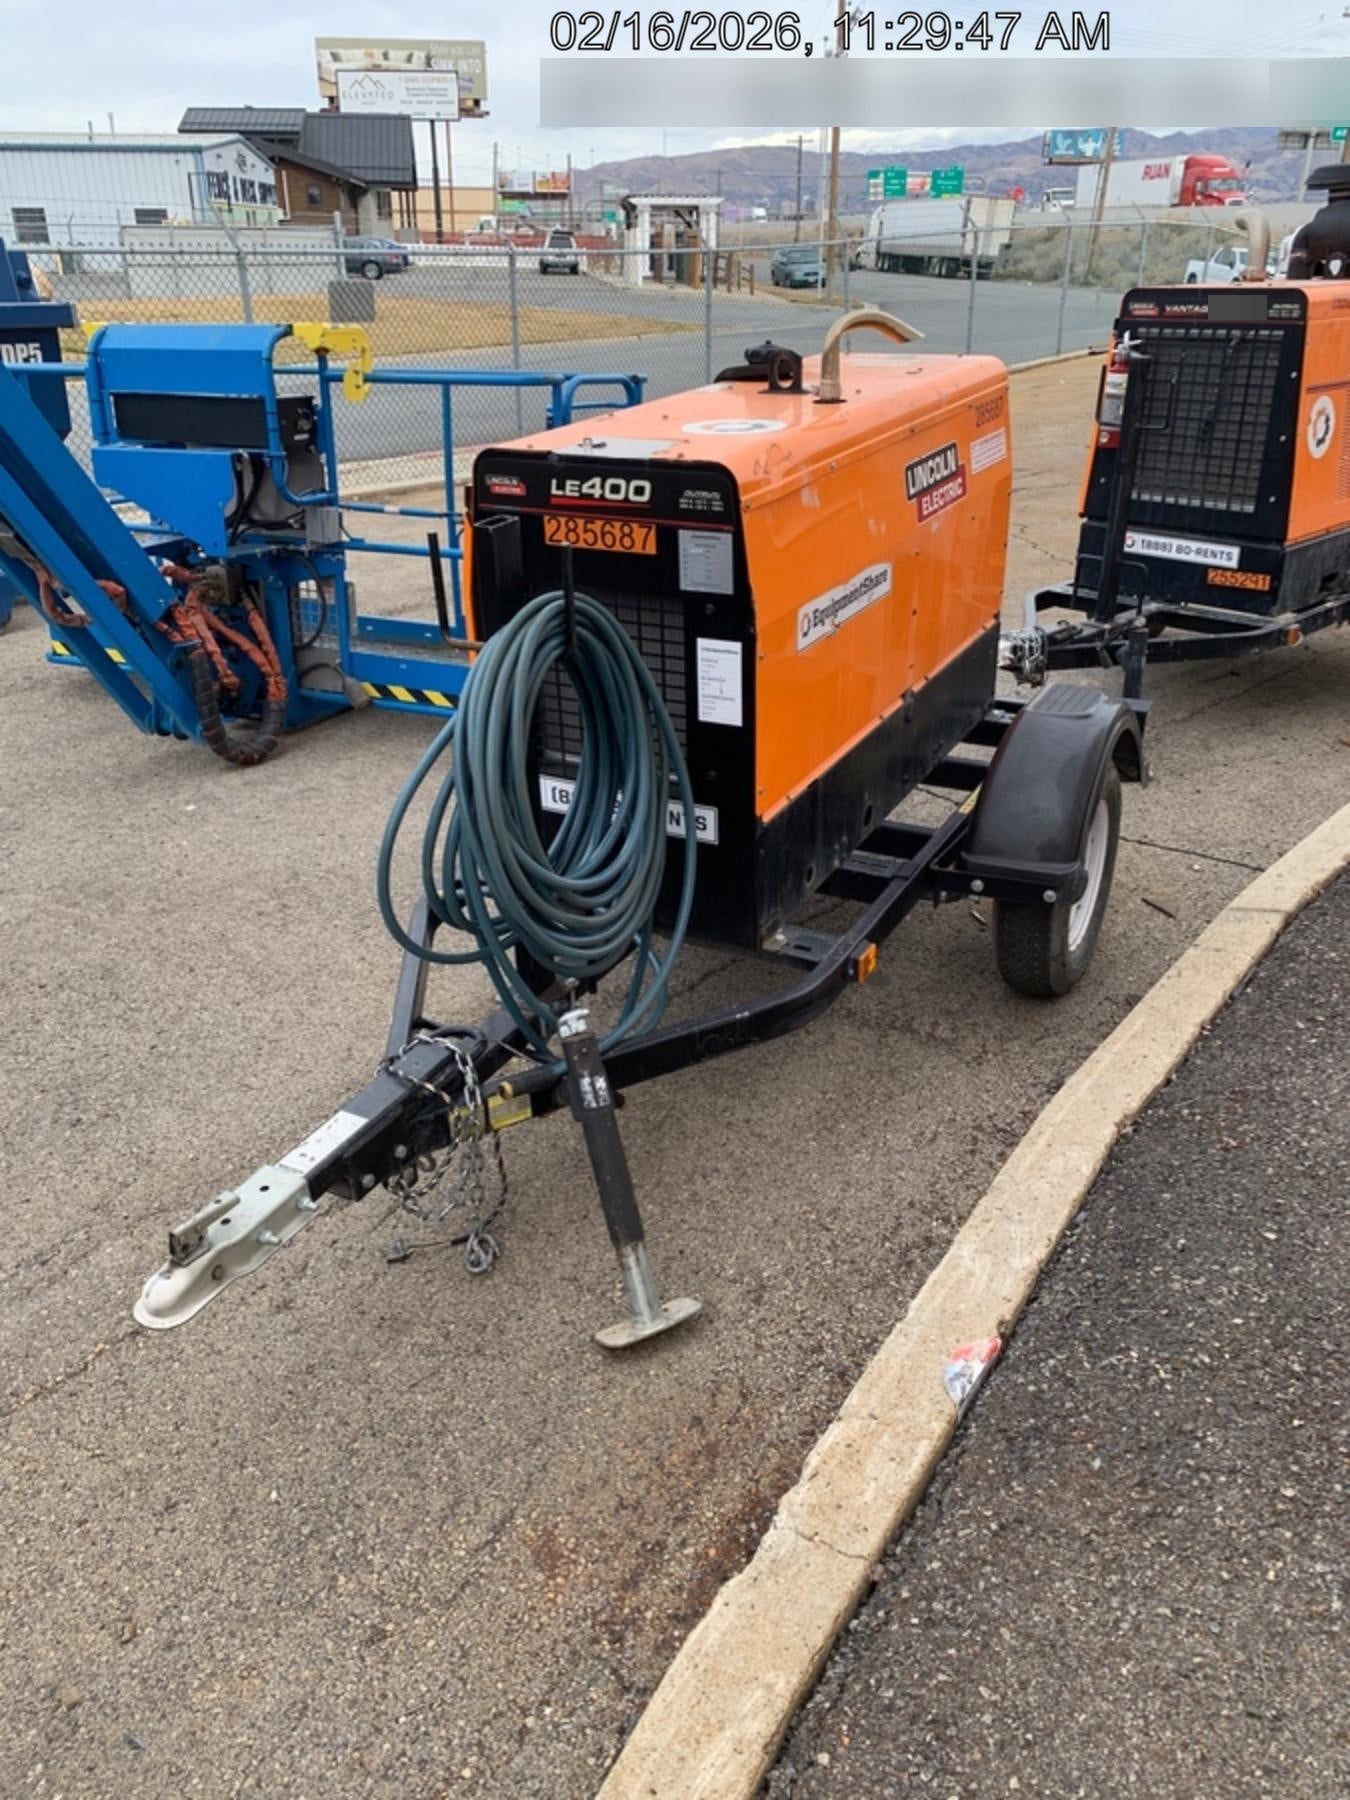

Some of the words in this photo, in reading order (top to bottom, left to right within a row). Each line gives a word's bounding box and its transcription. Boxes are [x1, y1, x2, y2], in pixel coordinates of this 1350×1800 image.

[1142, 162, 1172, 181] RUAN
[1164, 303, 1208, 313] VANTAG
[550, 476, 653, 503] LE400
[907, 448, 956, 497] LINCOLN
[920, 476, 963, 517] ELECTRIC
[547, 516, 654, 551] 285687
[812, 568, 889, 628] EquipmentShare
